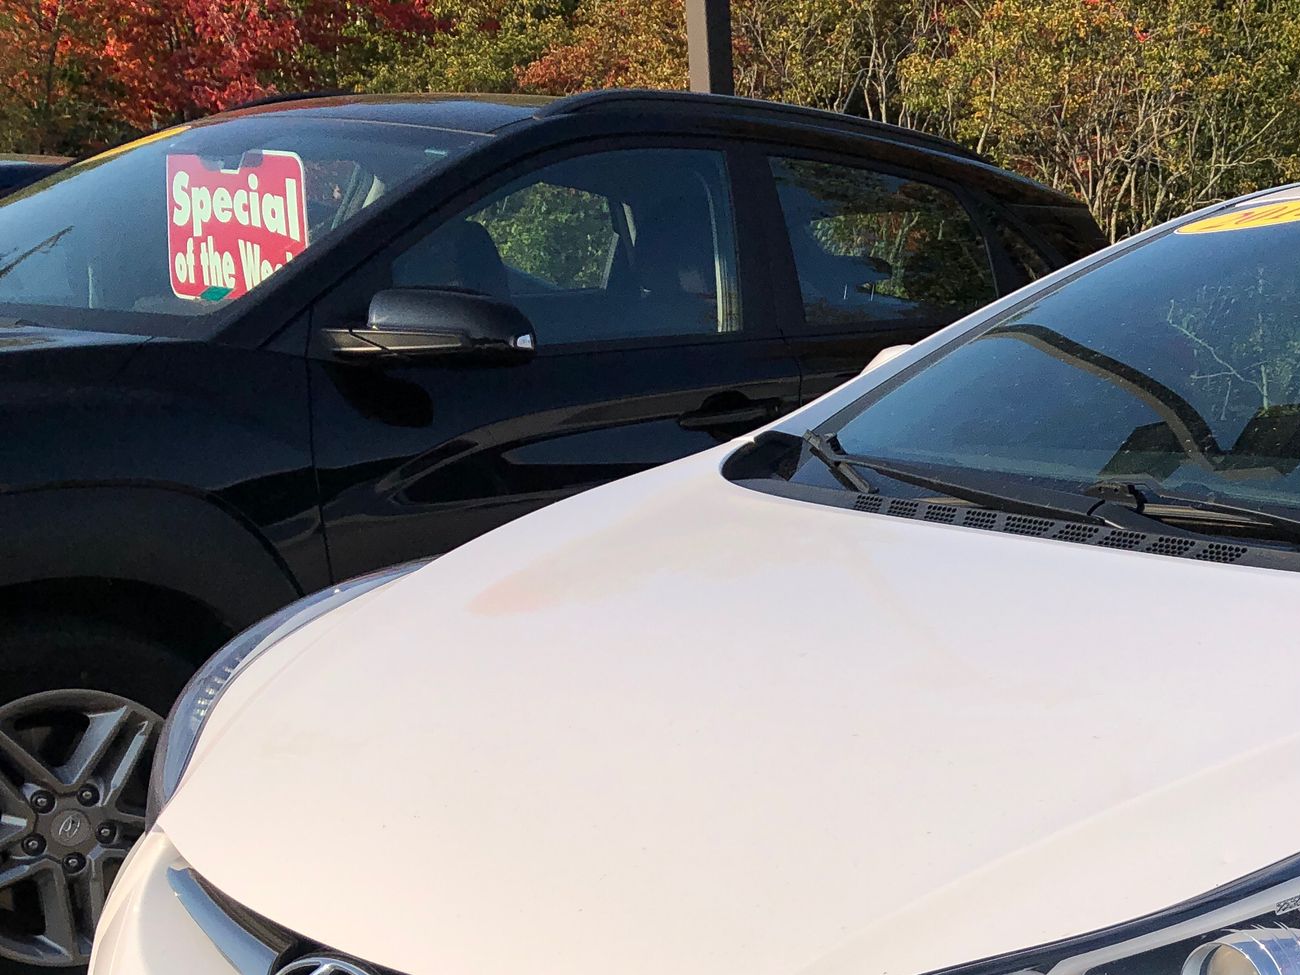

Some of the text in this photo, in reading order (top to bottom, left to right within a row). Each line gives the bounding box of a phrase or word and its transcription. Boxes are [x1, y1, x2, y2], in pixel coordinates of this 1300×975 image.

[172, 170, 301, 242] Special
[174, 235, 294, 291] of the We
